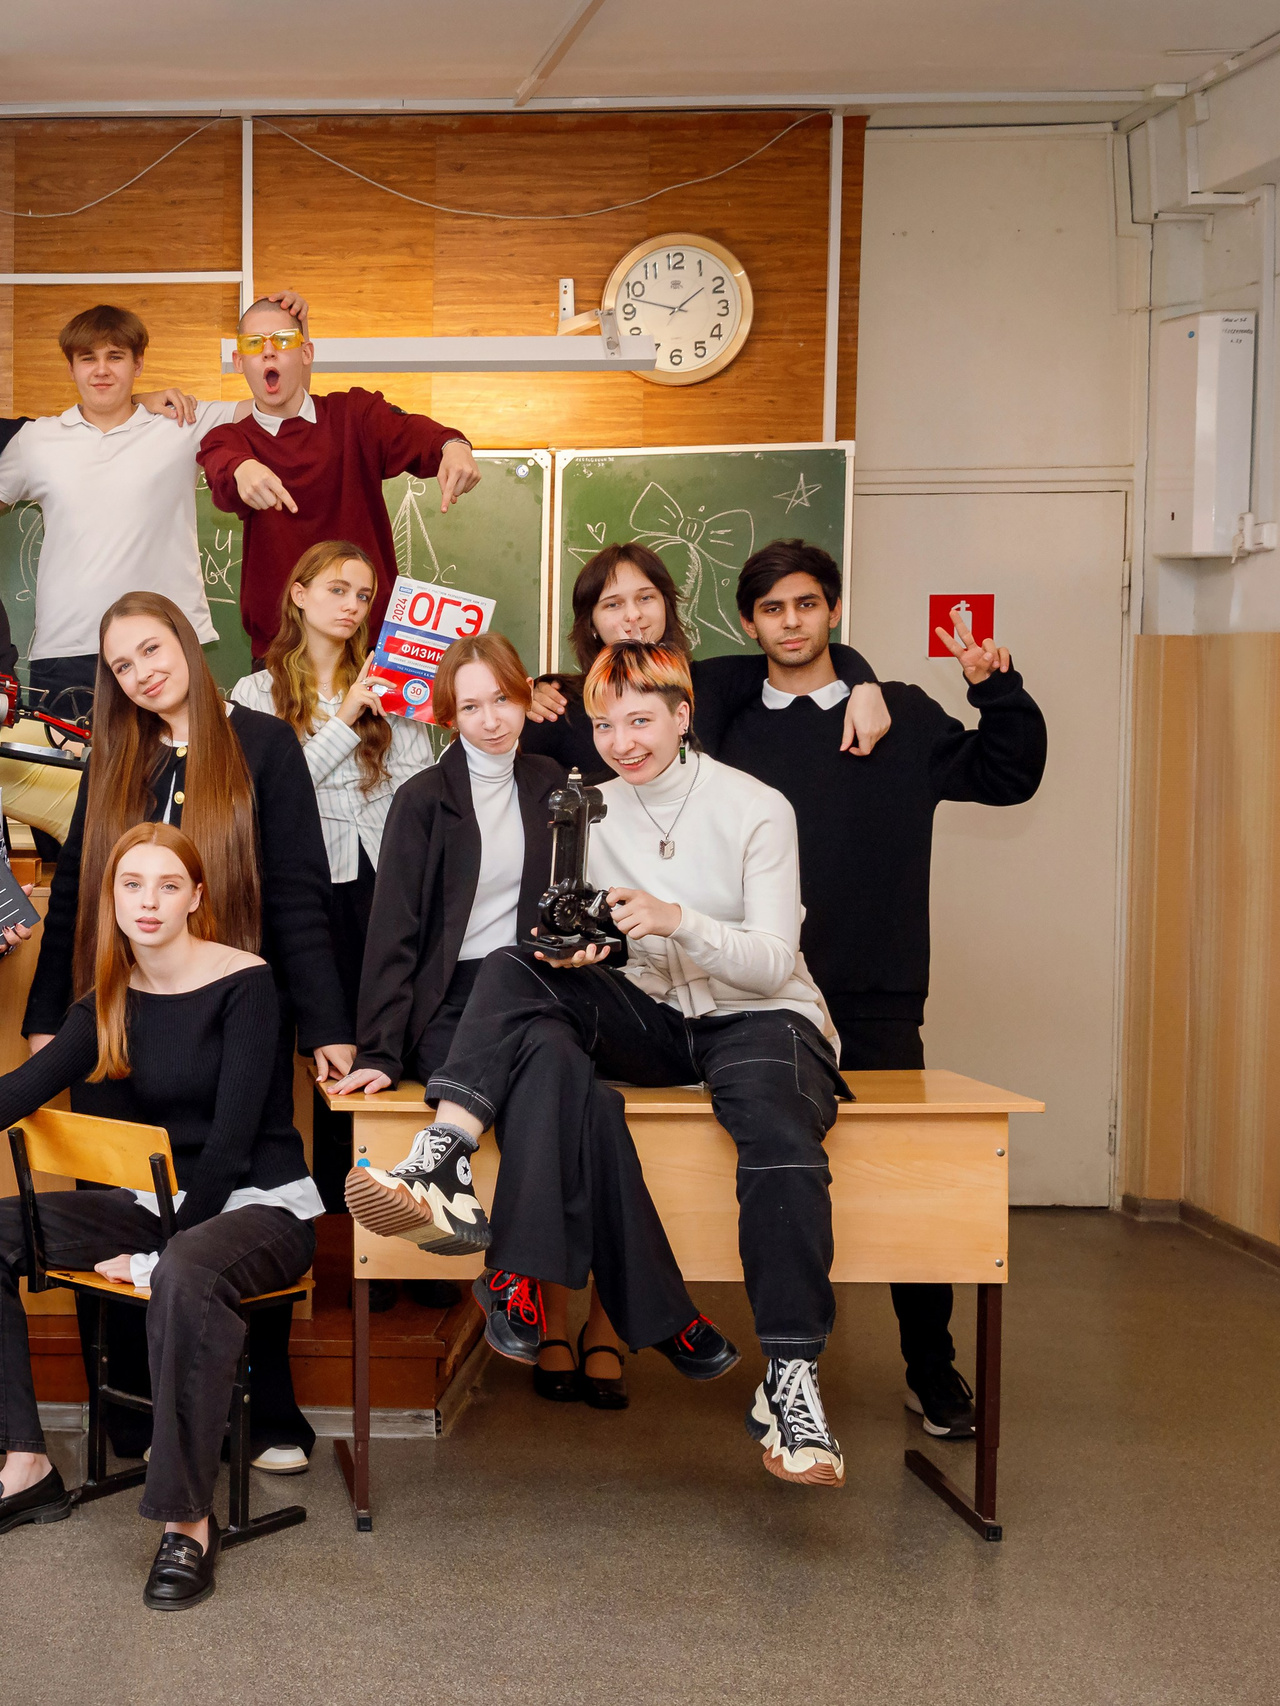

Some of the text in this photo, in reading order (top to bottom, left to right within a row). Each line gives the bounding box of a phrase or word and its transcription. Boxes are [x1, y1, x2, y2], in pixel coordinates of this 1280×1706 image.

[666, 252, 685, 270] 12
[697, 259, 703, 277] 1
[643, 261, 658, 280] 11
[625, 281, 645, 299] 10
[712, 276, 725, 294] 2
[622, 303, 636, 321] 9
[717, 299, 729, 317] 3
[710, 323, 723, 340] 4
[670, 349, 683, 366] 6
[694, 340, 707, 358] 5
[392, 598, 408, 622] 2024
[408, 591, 484, 638] ОГЭ
[401, 643, 444, 662] ФИЗИК
[410, 686, 422, 696] 30
